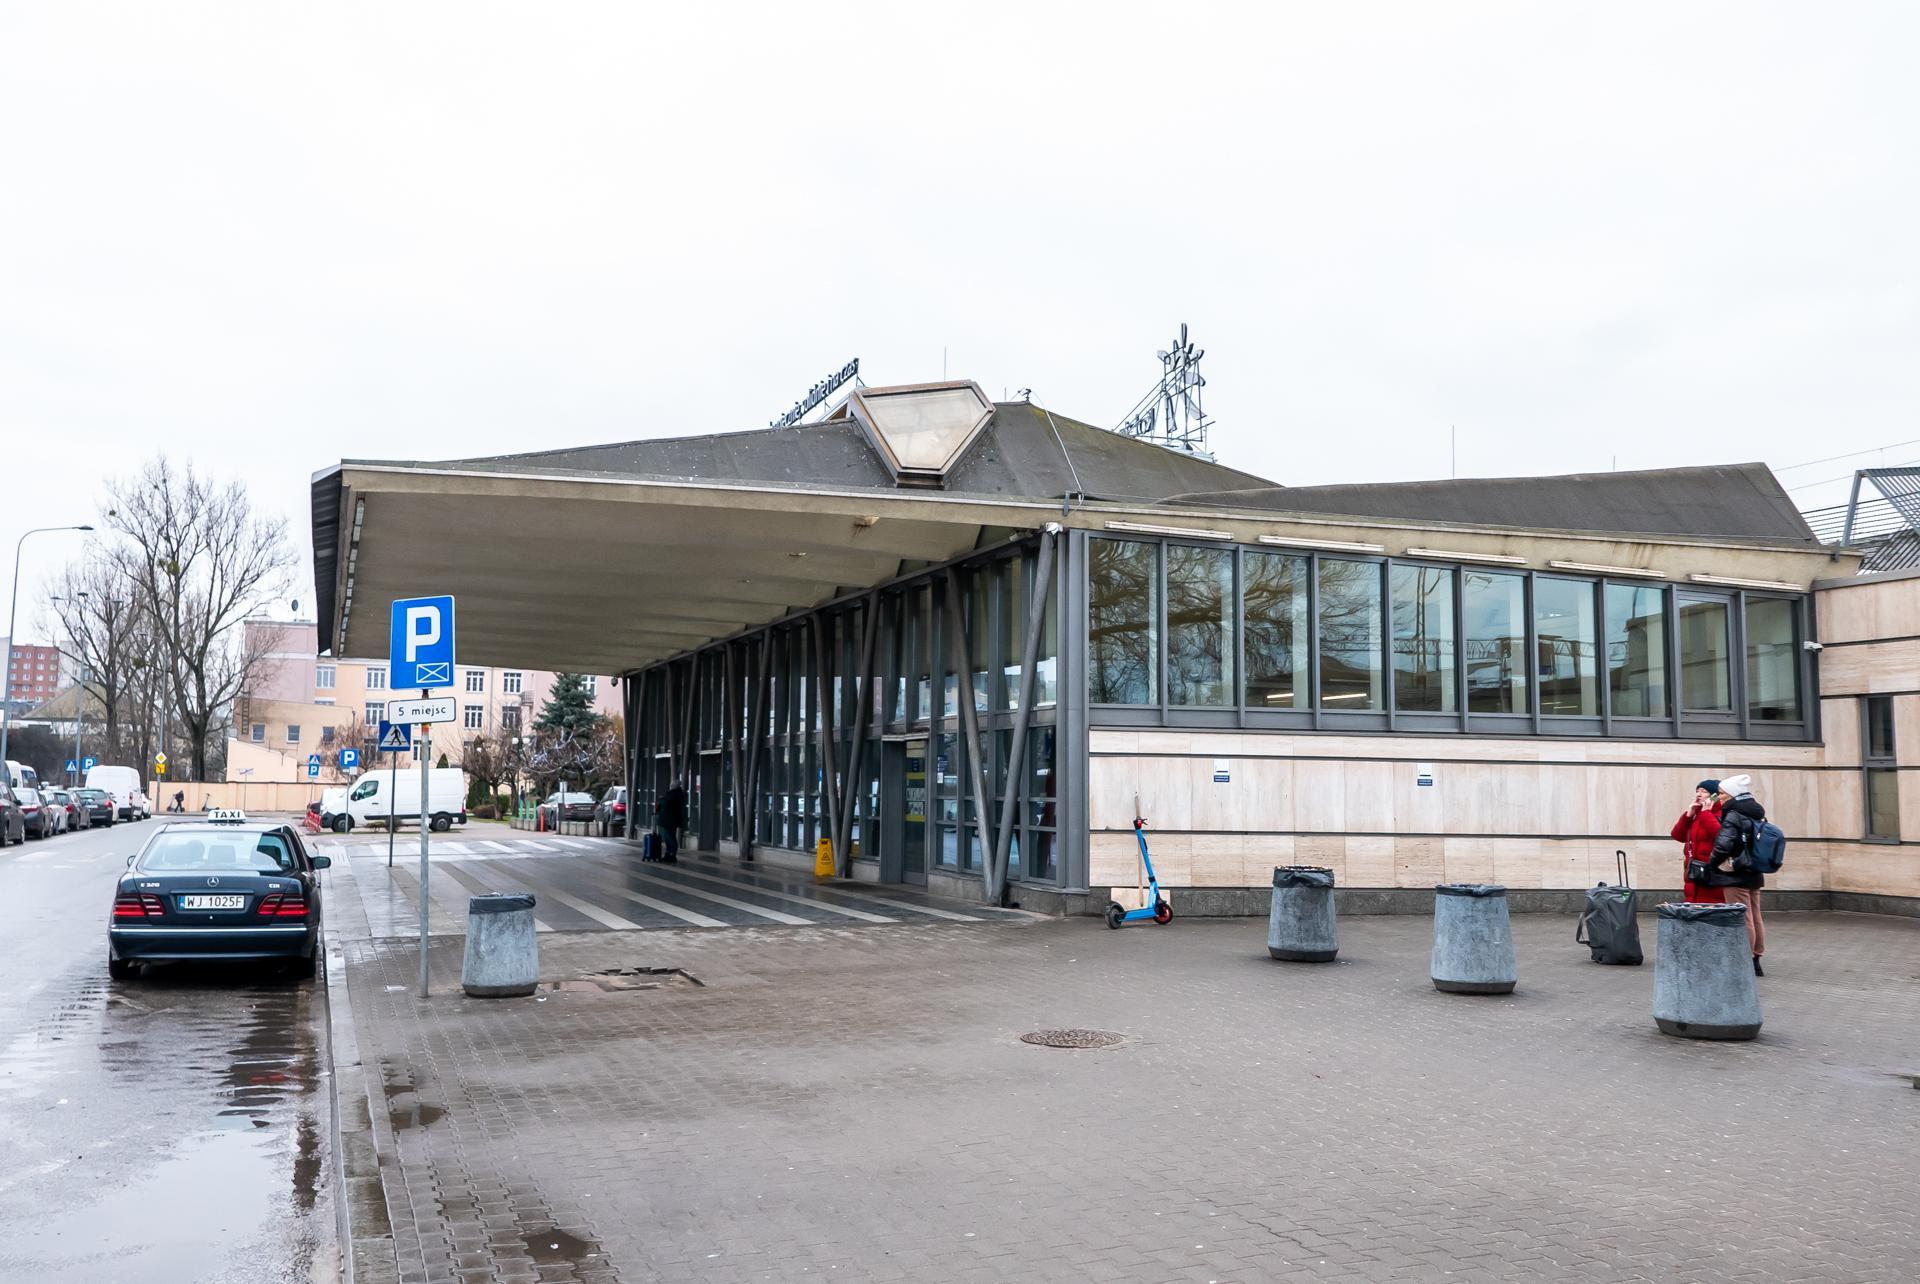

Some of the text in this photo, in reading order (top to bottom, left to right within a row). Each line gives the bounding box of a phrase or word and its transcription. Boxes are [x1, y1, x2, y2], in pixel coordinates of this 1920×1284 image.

[406, 606, 441, 662] P
[398, 705, 446, 717] 5 miejsc
[344, 750, 355, 765] P
[85, 759, 94, 769] P
[310, 766, 318, 775] P
[187, 896, 243, 908] WJ 1025F
